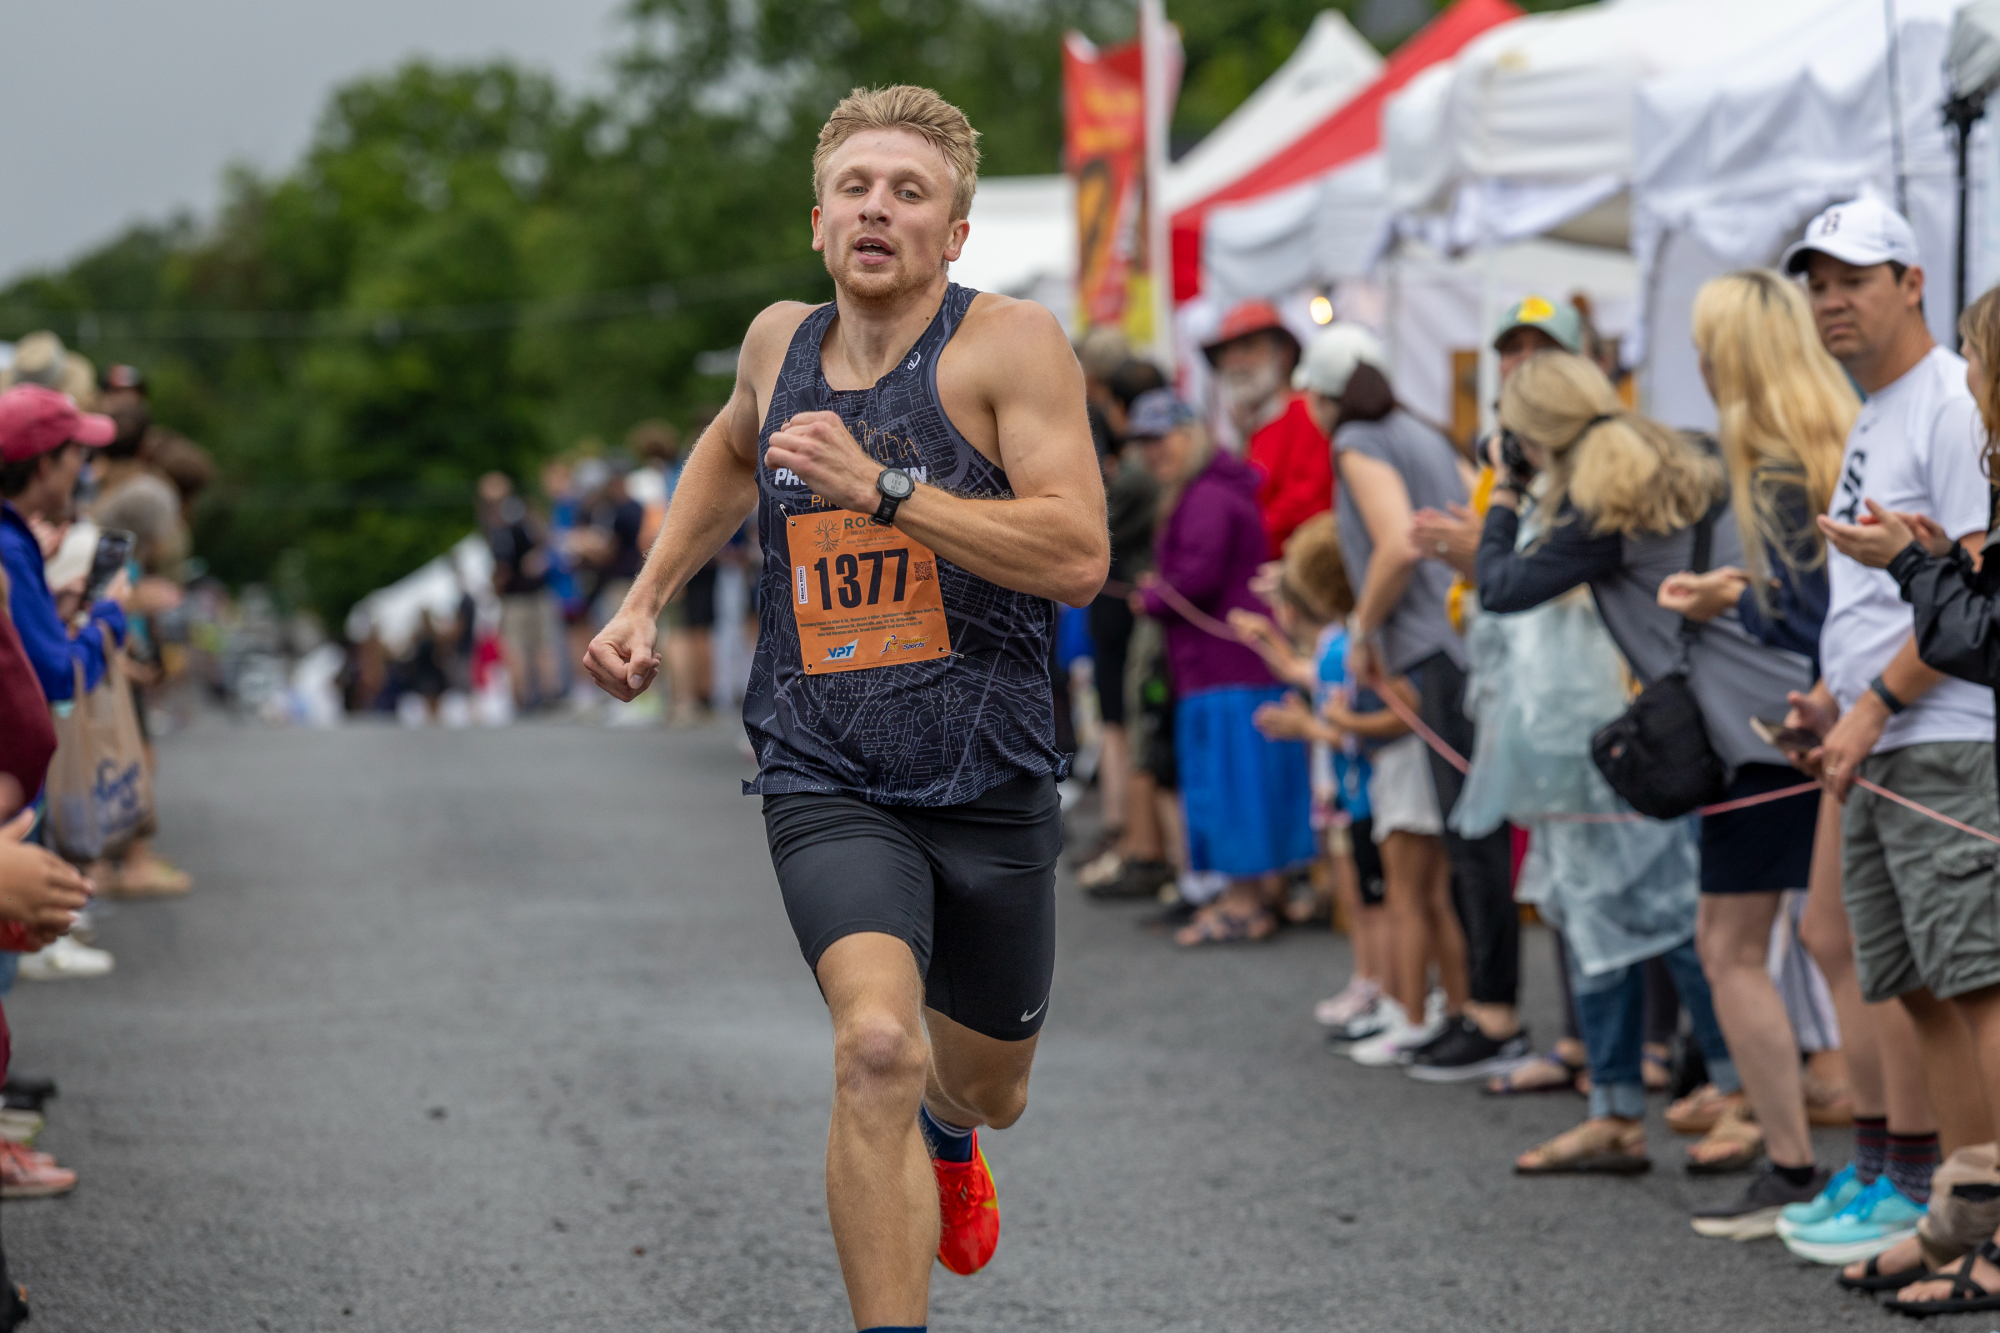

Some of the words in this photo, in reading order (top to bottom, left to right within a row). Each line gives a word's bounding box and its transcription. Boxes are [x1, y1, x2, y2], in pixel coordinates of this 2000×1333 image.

[814, 548, 909, 610] 1377
[828, 645, 854, 658] VPT
[903, 641, 924, 651] Sports
